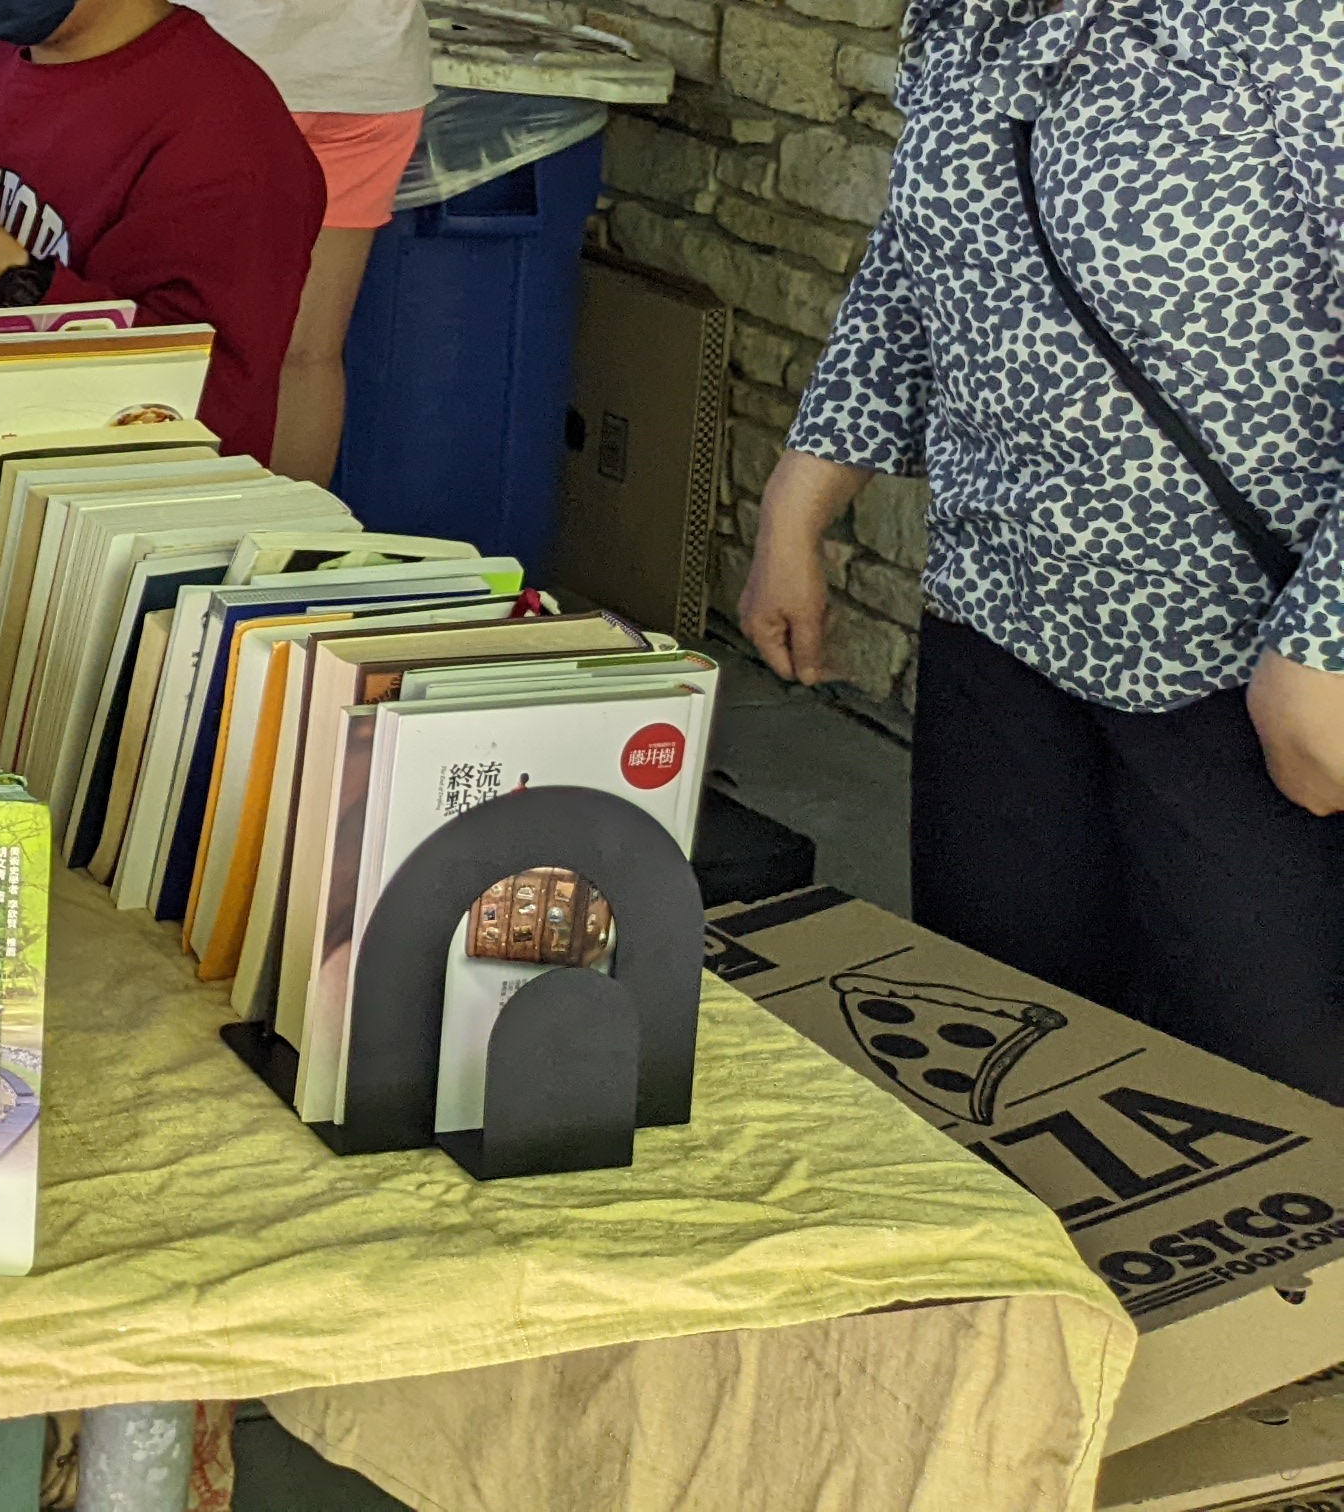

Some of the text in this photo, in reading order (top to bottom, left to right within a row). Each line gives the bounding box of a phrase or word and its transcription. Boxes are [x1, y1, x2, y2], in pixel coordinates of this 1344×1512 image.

[628, 748, 675, 766] 藤井樹
[1098, 1192, 1334, 1292] OSTCO
[1210, 1245, 1295, 1281] FOOD
